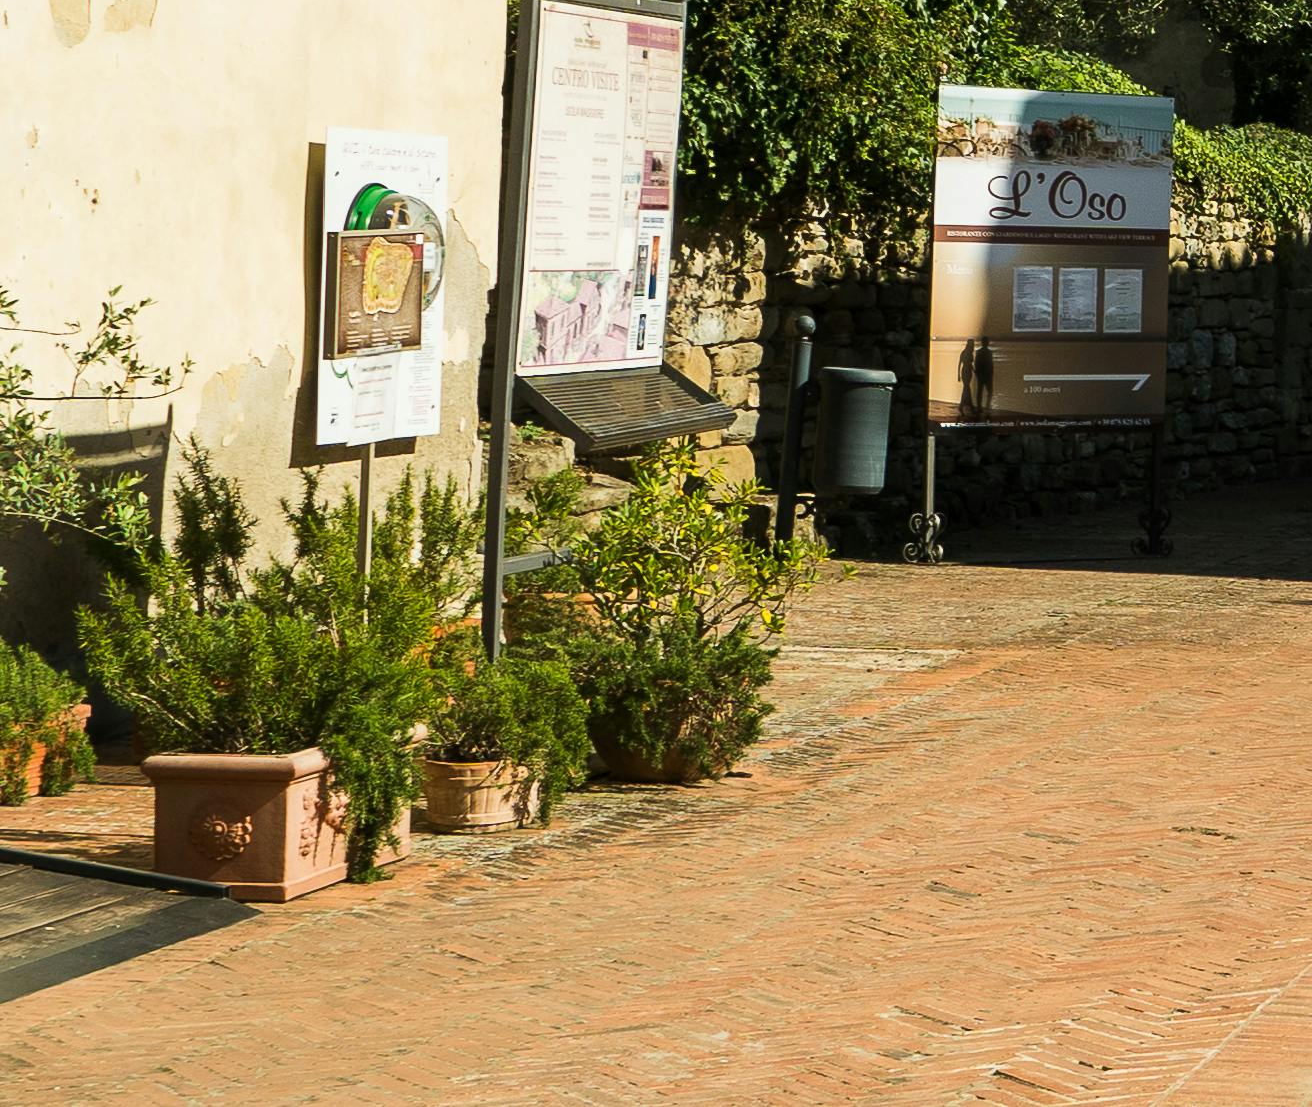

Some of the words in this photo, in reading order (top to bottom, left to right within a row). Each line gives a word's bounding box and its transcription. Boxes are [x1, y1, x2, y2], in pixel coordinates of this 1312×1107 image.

[552, 66, 590, 88] CENTRO
[591, 71, 620, 92] VISITE
[987, 169, 1127, 221] L'Oso
